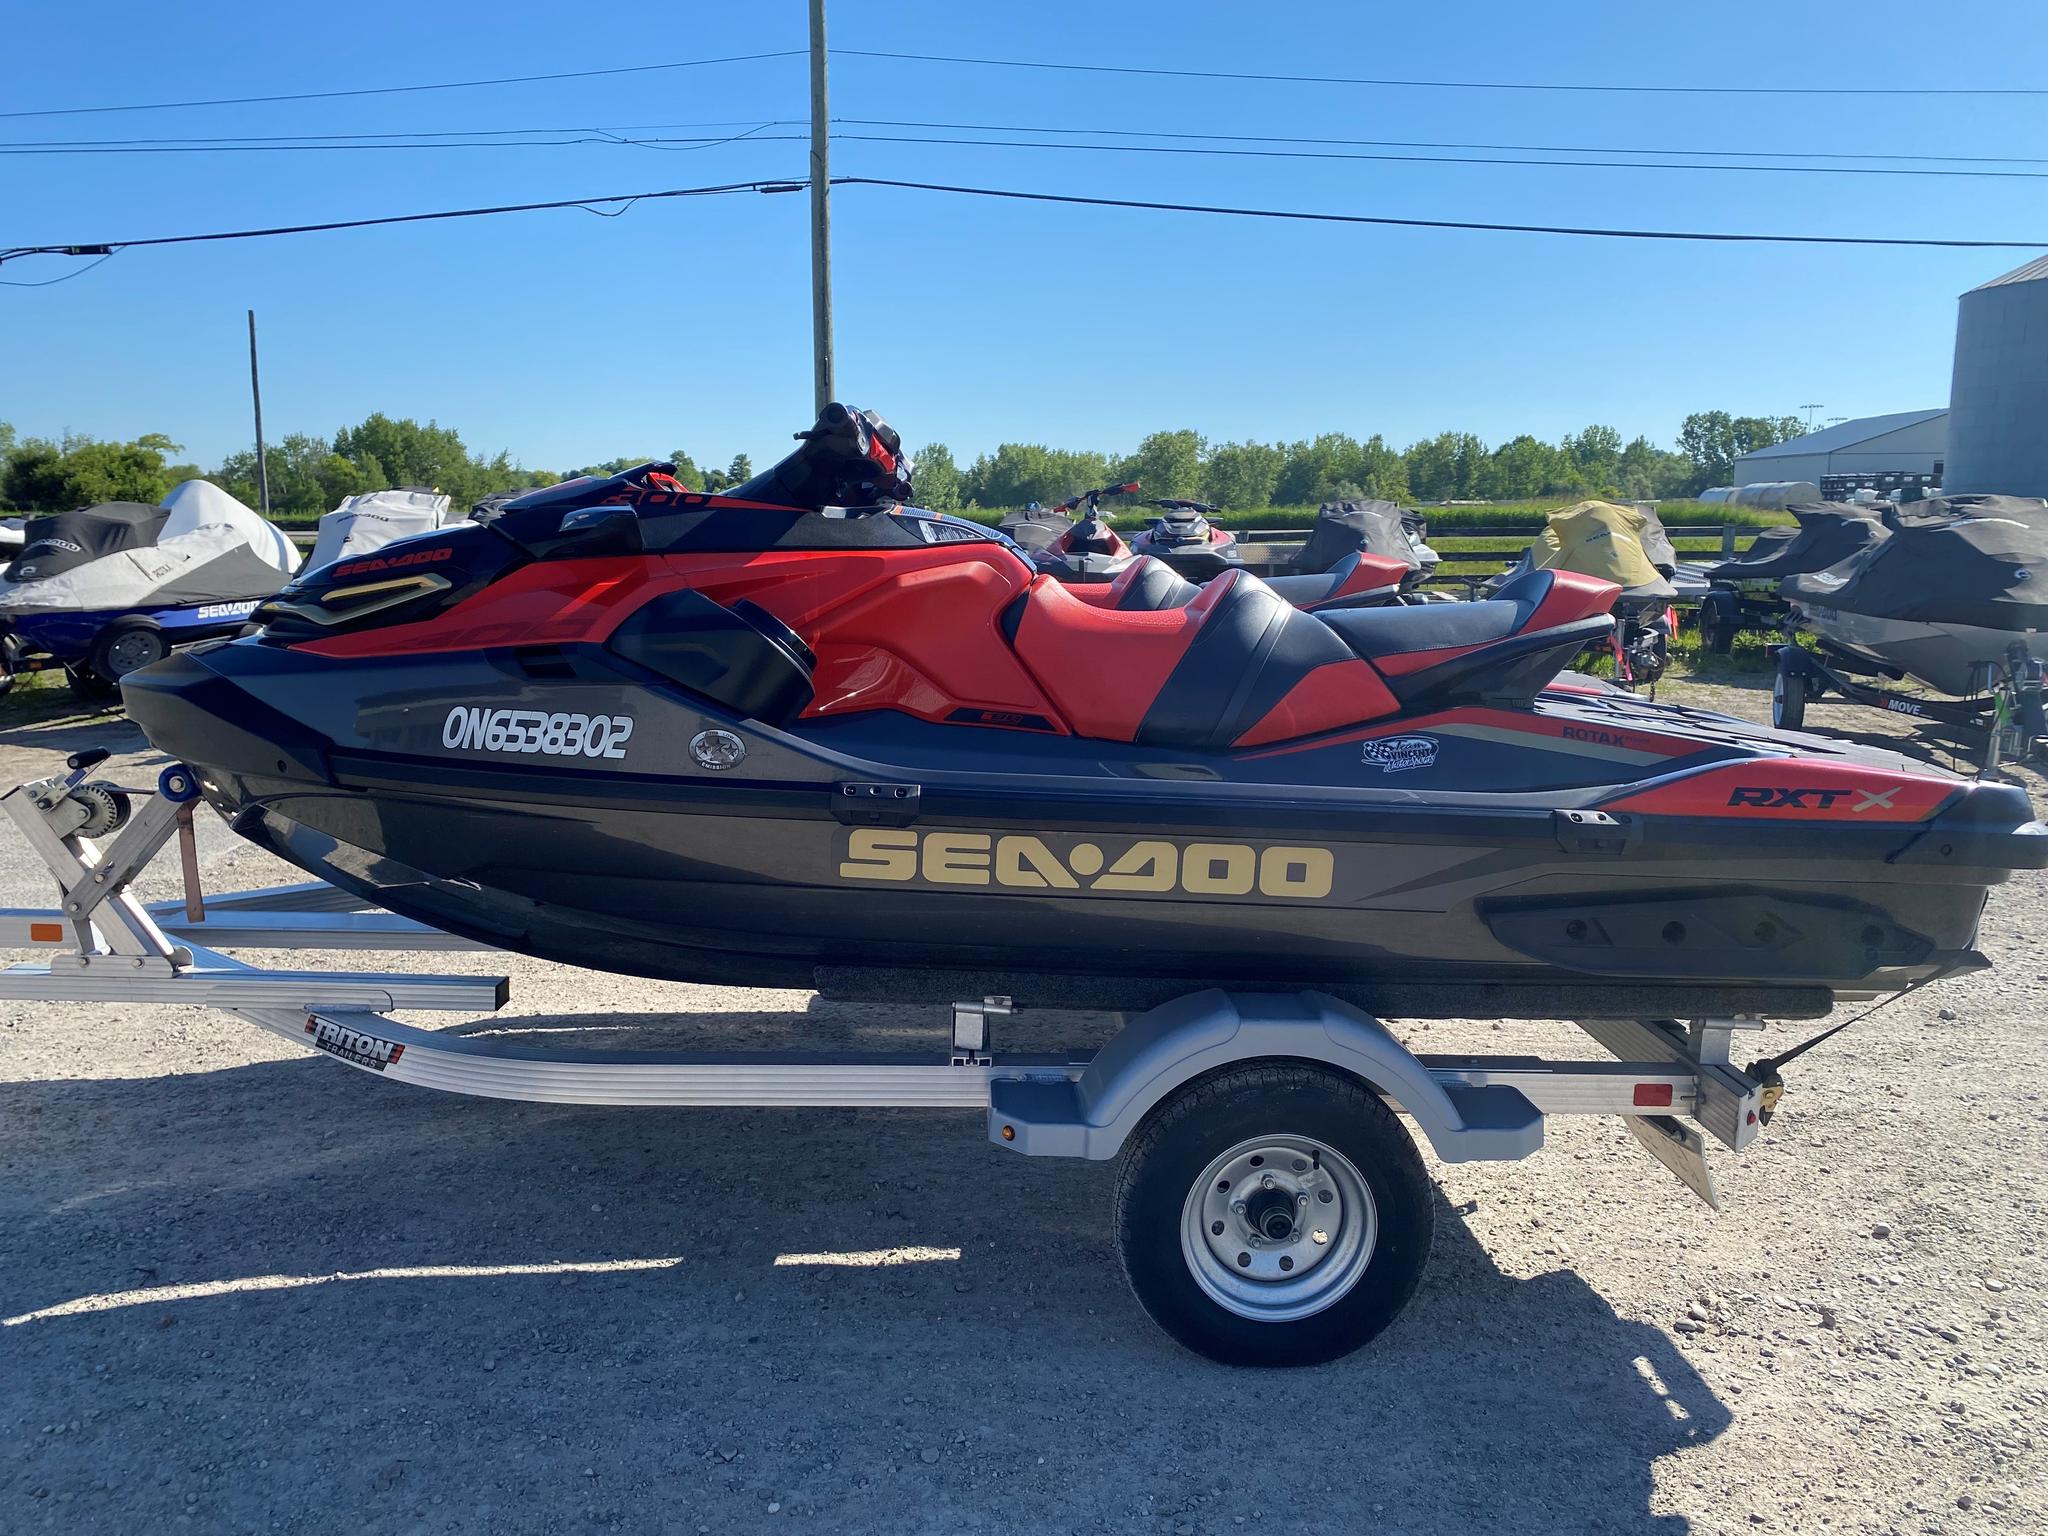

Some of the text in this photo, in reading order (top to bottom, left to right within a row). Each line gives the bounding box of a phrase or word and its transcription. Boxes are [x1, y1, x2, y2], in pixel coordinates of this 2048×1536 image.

[1888, 699, 1922, 715] MOVE
[442, 705, 634, 760] ON6538302
[1562, 726, 1625, 747] ROTAX
[1390, 748, 1430, 761] VINCENT
[1727, 786, 1853, 809] RXT
[314, 1017, 394, 1061] TRITON
[325, 1042, 378, 1068] TRAILERS
